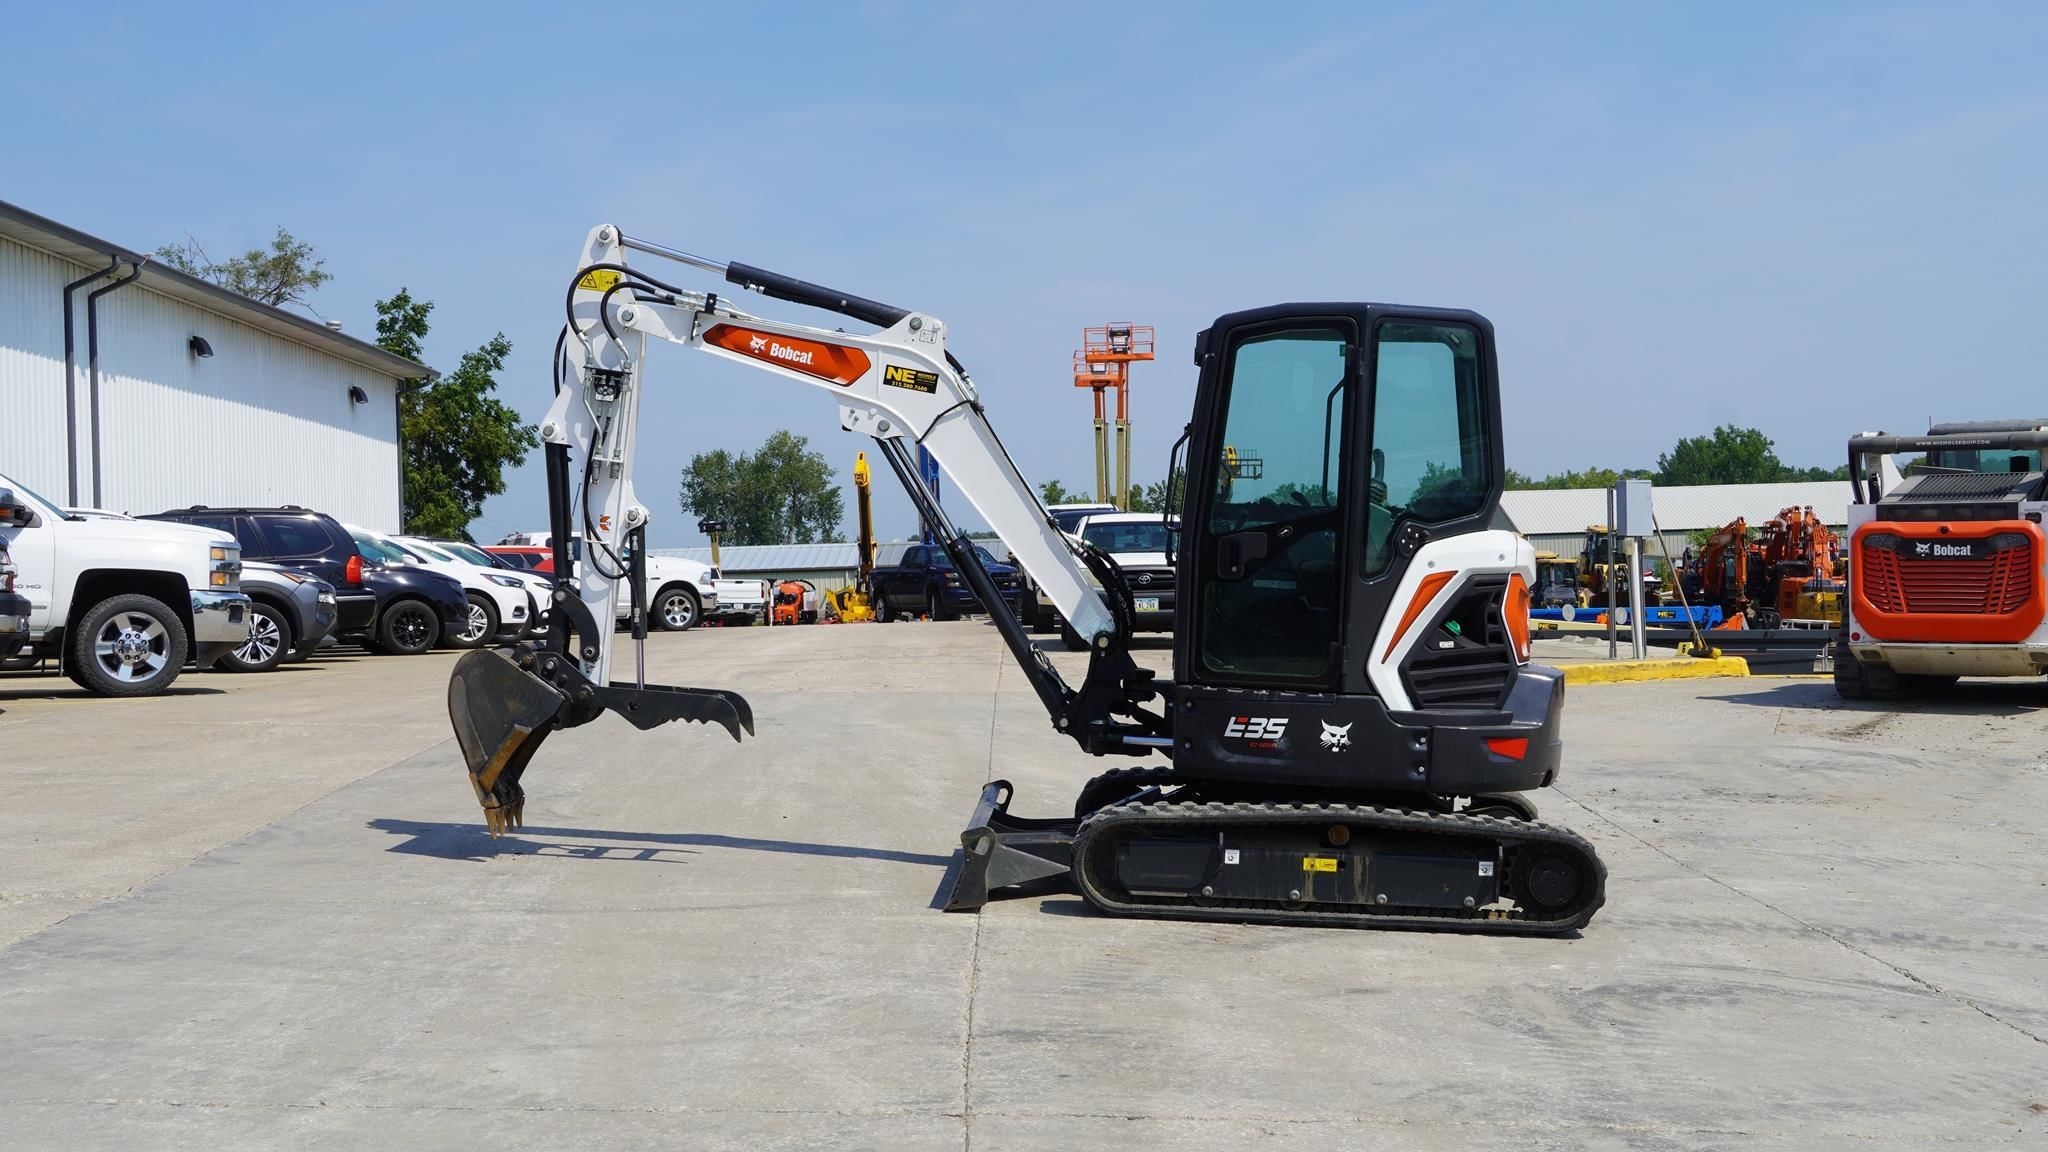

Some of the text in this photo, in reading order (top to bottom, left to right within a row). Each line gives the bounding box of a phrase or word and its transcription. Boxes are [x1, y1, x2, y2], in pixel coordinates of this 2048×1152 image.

[769, 342, 813, 365] Bobcat
[886, 366, 916, 384] NE
[1933, 544, 1972, 556] Bobcat
[1224, 716, 1289, 739] E35
